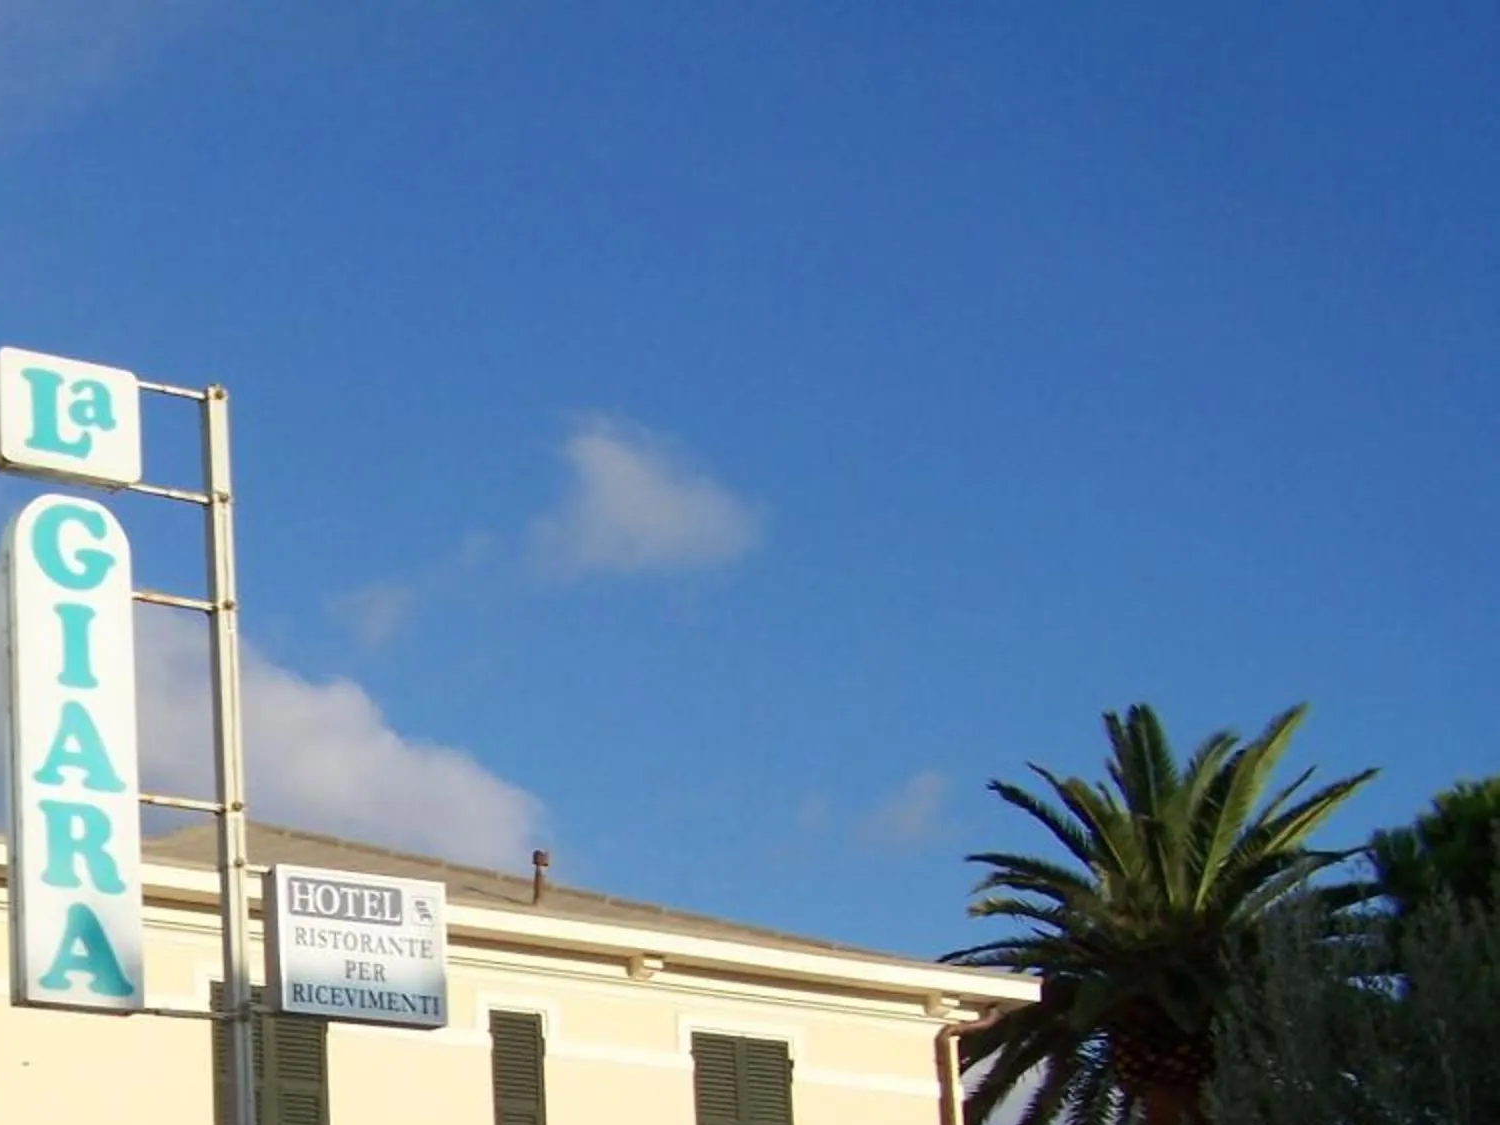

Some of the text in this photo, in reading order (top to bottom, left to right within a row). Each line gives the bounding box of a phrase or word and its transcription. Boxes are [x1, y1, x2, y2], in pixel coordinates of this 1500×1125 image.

[20, 366, 117, 460] La
[30, 502, 136, 1000] GIARA
[291, 880, 400, 922] HOTEL
[295, 926, 434, 960] RISTORANTE
[344, 959, 388, 983] PER
[292, 982, 441, 1017] RICEVIMENTI
